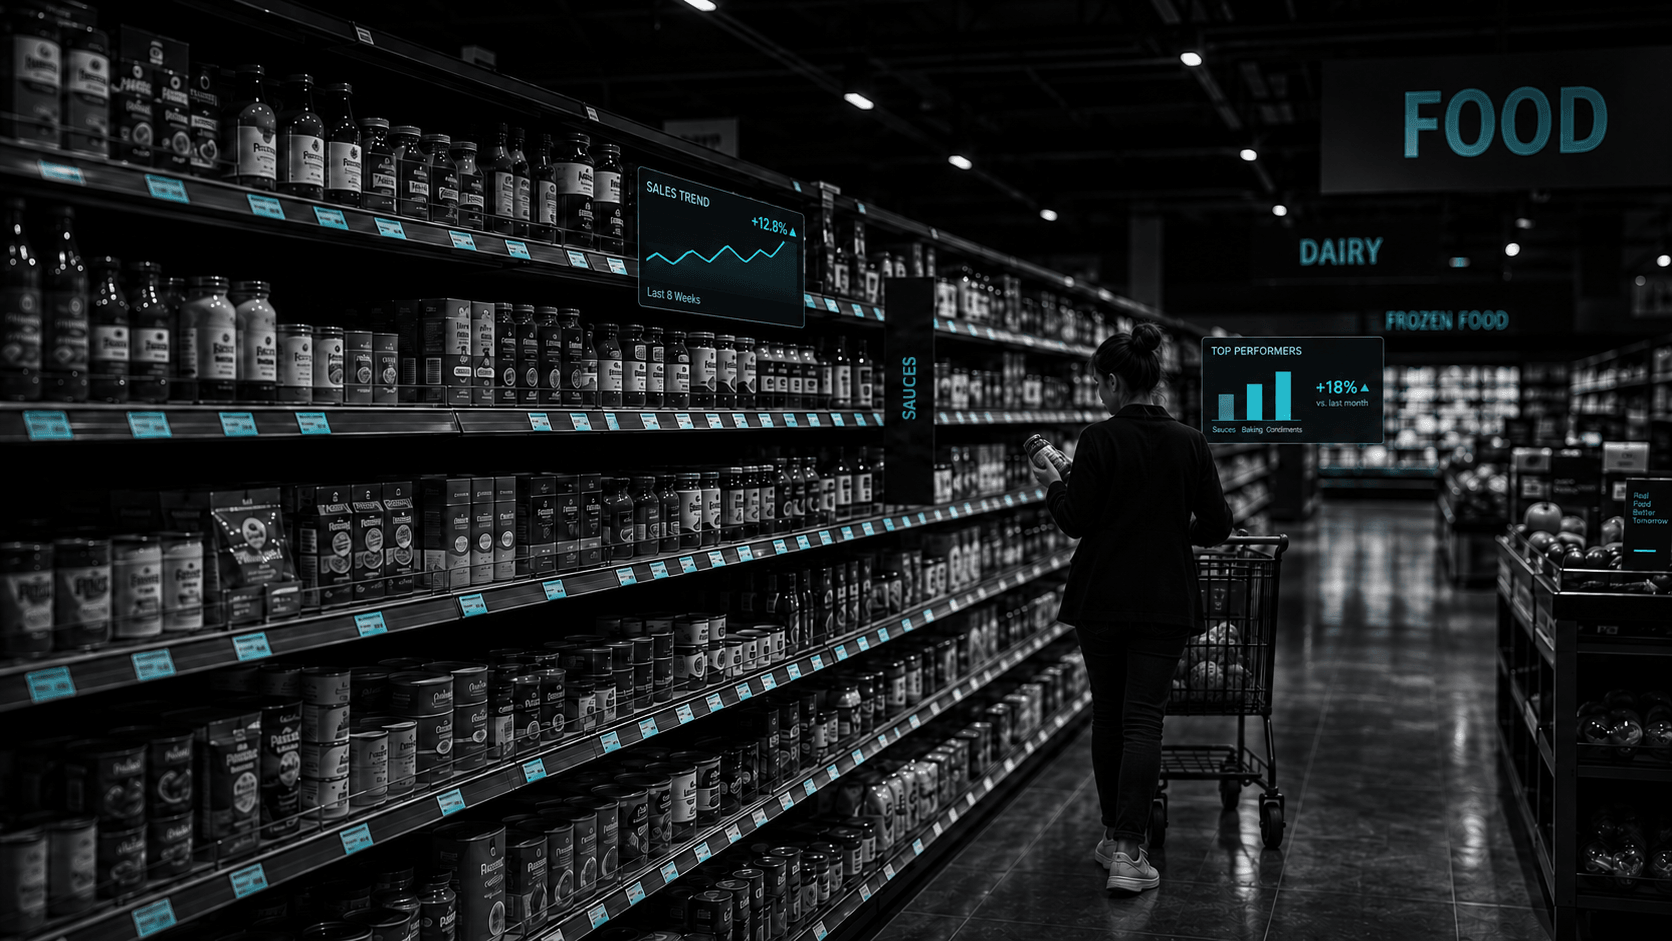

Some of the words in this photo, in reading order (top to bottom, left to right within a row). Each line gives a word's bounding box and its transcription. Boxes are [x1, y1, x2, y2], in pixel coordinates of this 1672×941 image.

[1403, 86, 1608, 159] FOOD
[646, 181, 677, 199] SALES
[679, 190, 710, 208] TREND
[751, 216, 788, 236] +12.8%
[1299, 237, 1383, 266] DAIRY
[647, 286, 665, 299] Last
[666, 289, 673, 300] 8
[674, 291, 701, 305] Weeks
[1385, 310, 1453, 331] FROZEN
[1457, 310, 1510, 331] FOOD
[1211, 346, 1232, 356] TOP
[1234, 346, 1303, 356] PERFORMERS
[901, 356, 917, 420] SAUCES
[1316, 380, 1358, 395] +18%
[1328, 399, 1342, 407] last
[1343, 399, 1369, 407] month
[1212, 425, 1237, 434] Sauces
[1241, 425, 1264, 435] Baking
[1633, 491, 1650, 499] Real
[1632, 516, 1669, 525] Tomorrow
